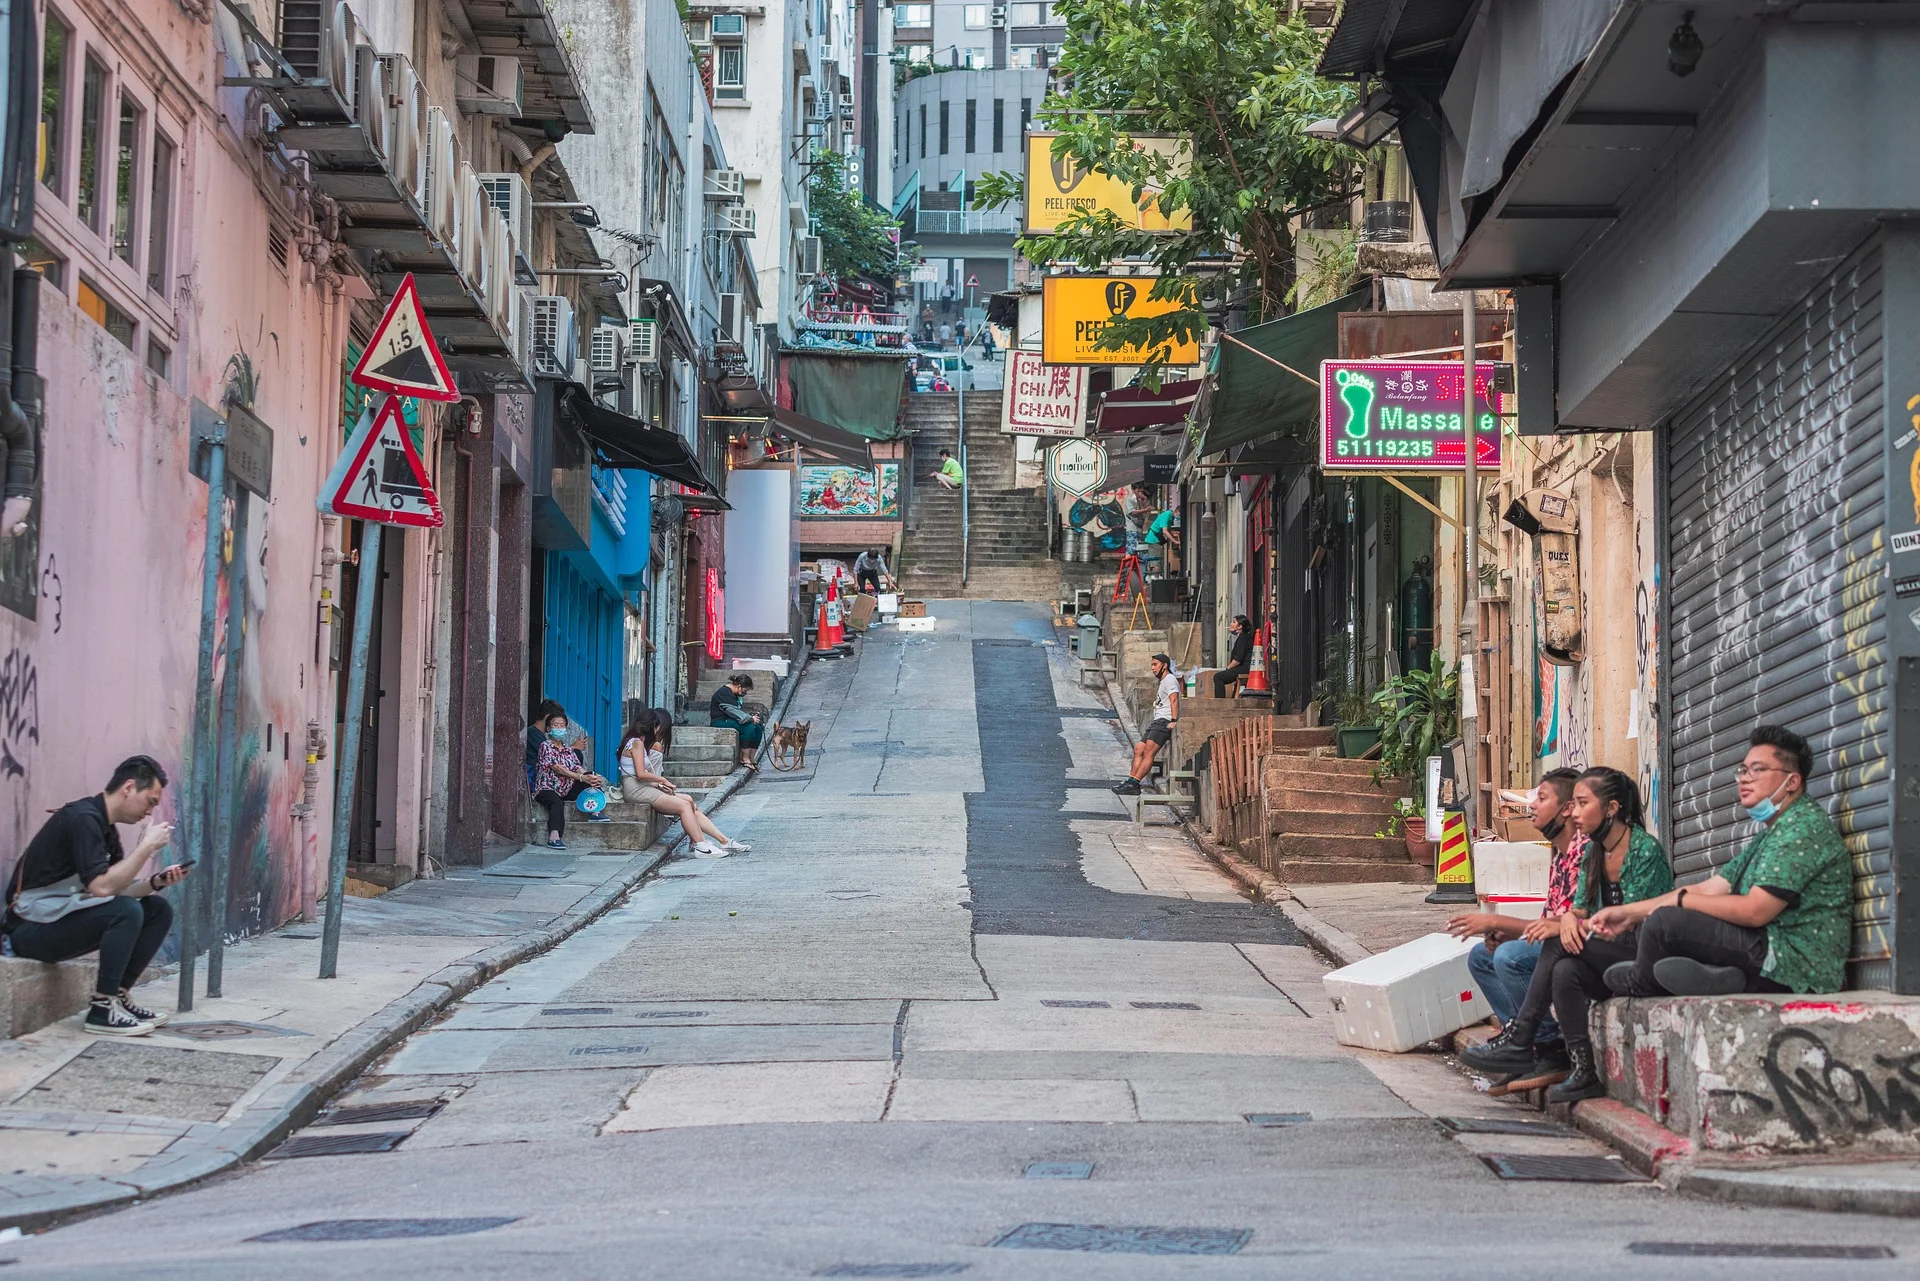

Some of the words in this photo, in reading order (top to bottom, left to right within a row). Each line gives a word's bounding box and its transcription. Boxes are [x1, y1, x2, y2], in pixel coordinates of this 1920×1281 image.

[1045, 198, 1064, 209] PEEL
[1076, 321, 1106, 341] PEE
[389, 329, 413, 356] 1:5
[1021, 361, 1046, 376] CHI
[1020, 381, 1045, 397] CHI
[1018, 402, 1071, 419] CHAM
[1380, 406, 1495, 431] Massae
[1337, 439, 1433, 457] 51119235
[1060, 461, 1098, 471] moment
[1075, 453, 1083, 463] le
[1443, 875, 1466, 883] FEHD
